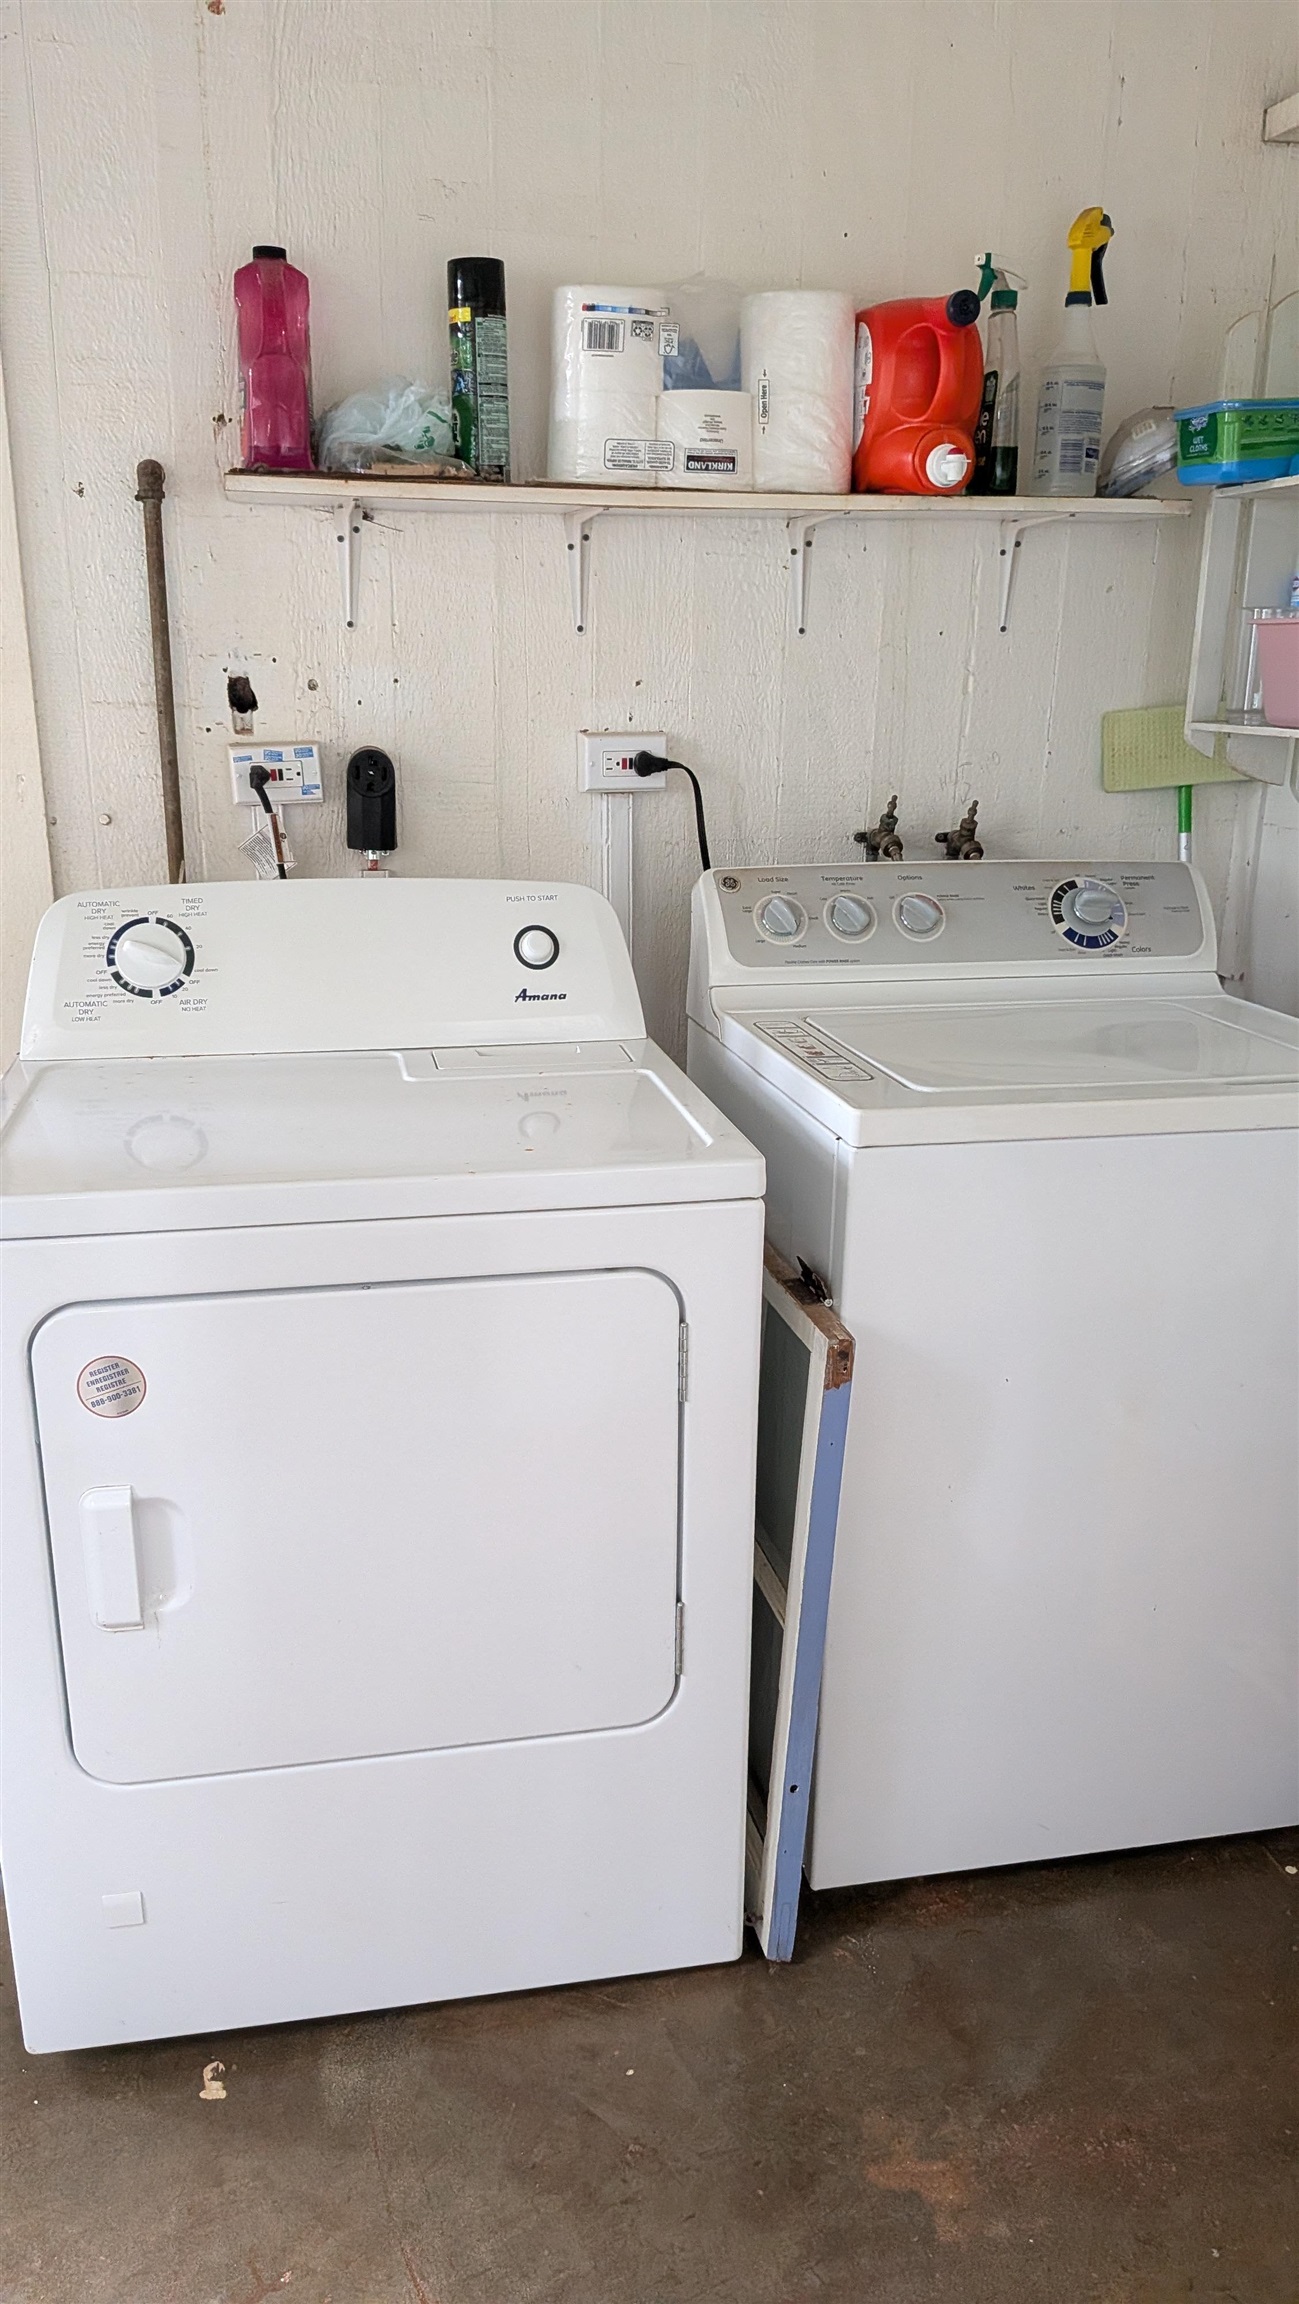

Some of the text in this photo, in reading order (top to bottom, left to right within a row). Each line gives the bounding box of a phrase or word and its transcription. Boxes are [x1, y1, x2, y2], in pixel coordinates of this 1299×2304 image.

[760, 384, 769, 419] Open Here
[1193, 436, 1204, 444] WET
[687, 460, 734, 471] KIRKLAND
[821, 875, 864, 883] Temperature
[77, 900, 121, 908] AUTOMATIC
[514, 987, 567, 1003] Amana
[63, 1000, 108, 1008] AUTOMATIC
[192, 998, 209, 1006] DRY
[89, 1362, 120, 1377] REGISTER
[86, 1368, 130, 1387] ENREGISTRER
[95, 1378, 127, 1393] REGISTRE
[91, 1385, 141, 1408] 888-900-3381
